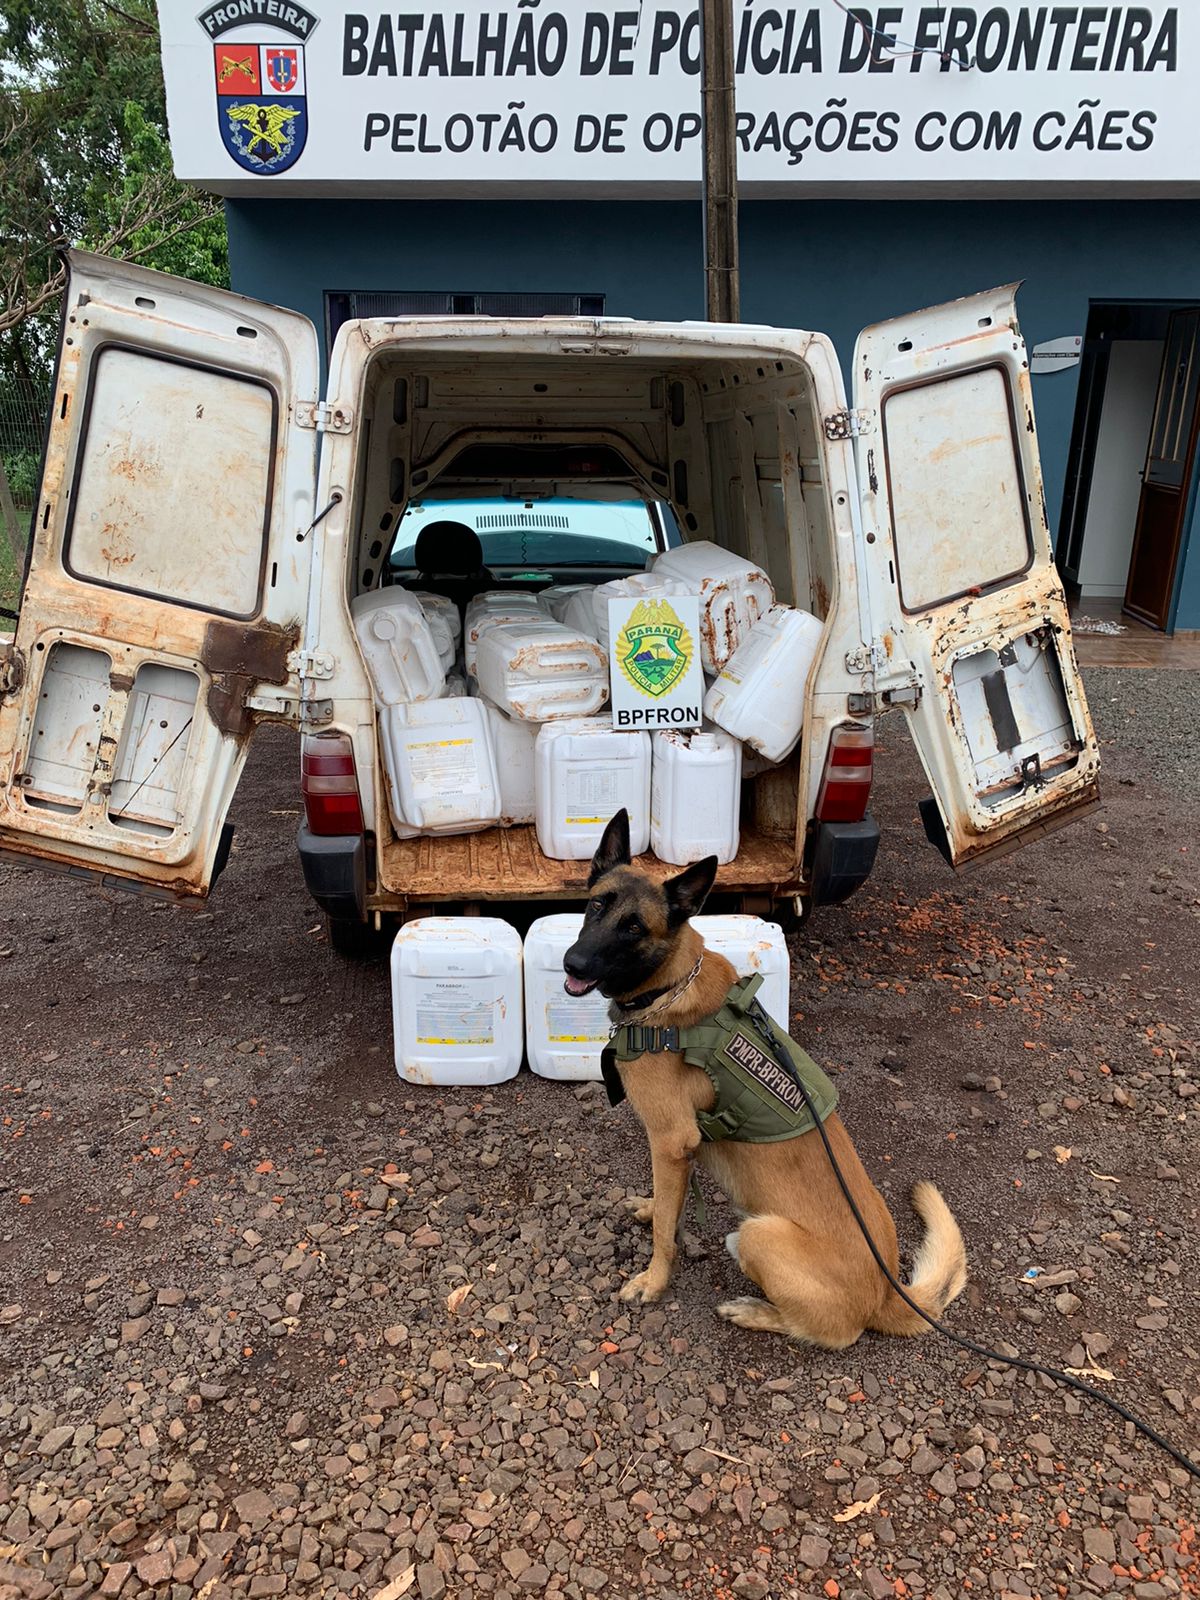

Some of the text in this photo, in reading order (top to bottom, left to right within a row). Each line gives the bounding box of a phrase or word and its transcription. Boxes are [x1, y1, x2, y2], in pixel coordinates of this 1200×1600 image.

[203, 0, 308, 34] FRONTEIRA
[342, 0, 1178, 77] BATALHÃO DE POÍCIA DE FRONTEIRA
[363, 97, 1157, 166] PELOTÃO DE OPRAÇÕES COM CÃES
[628, 626, 679, 640] PARANÁ
[659, 658, 683, 689] MILITAR
[618, 706, 699, 726] BPFRON
[729, 1036, 804, 1108] PMPR-BPFRON
